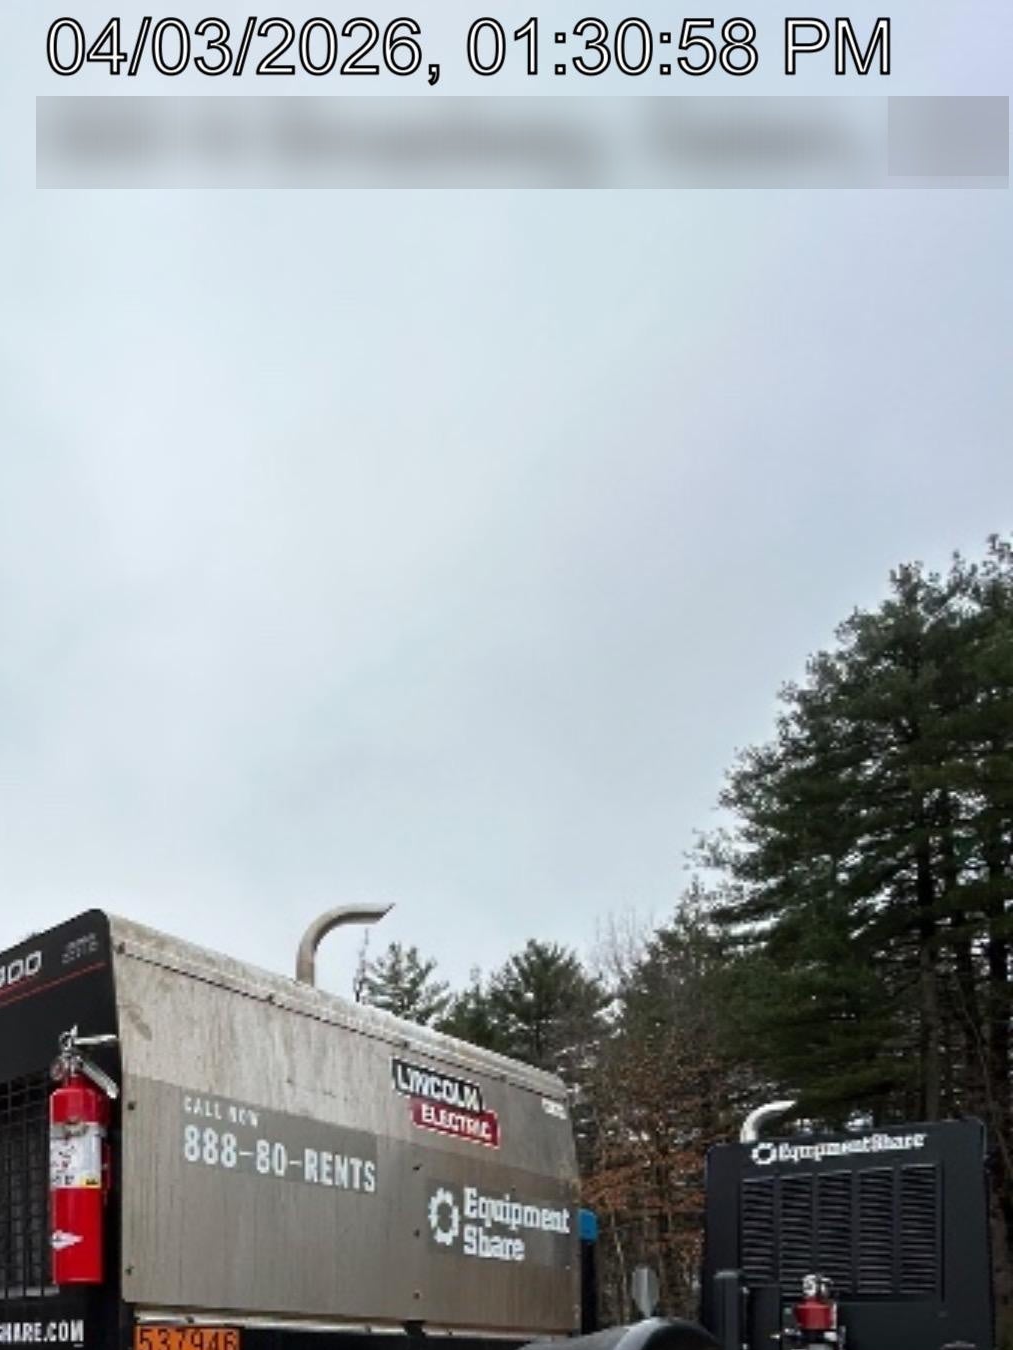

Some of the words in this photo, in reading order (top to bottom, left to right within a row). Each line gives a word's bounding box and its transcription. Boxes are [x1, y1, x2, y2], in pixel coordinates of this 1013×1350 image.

[397, 1063, 481, 1112] LINCOLN
[184, 1097, 222, 1120] CALL
[421, 1103, 492, 1140] ELECTRIC
[184, 1124, 376, 1193] 888-80-RENTS
[778, 1132, 927, 1163] EquipmentShare
[463, 1186, 571, 1234] Equipment
[463, 1223, 526, 1261] Share
